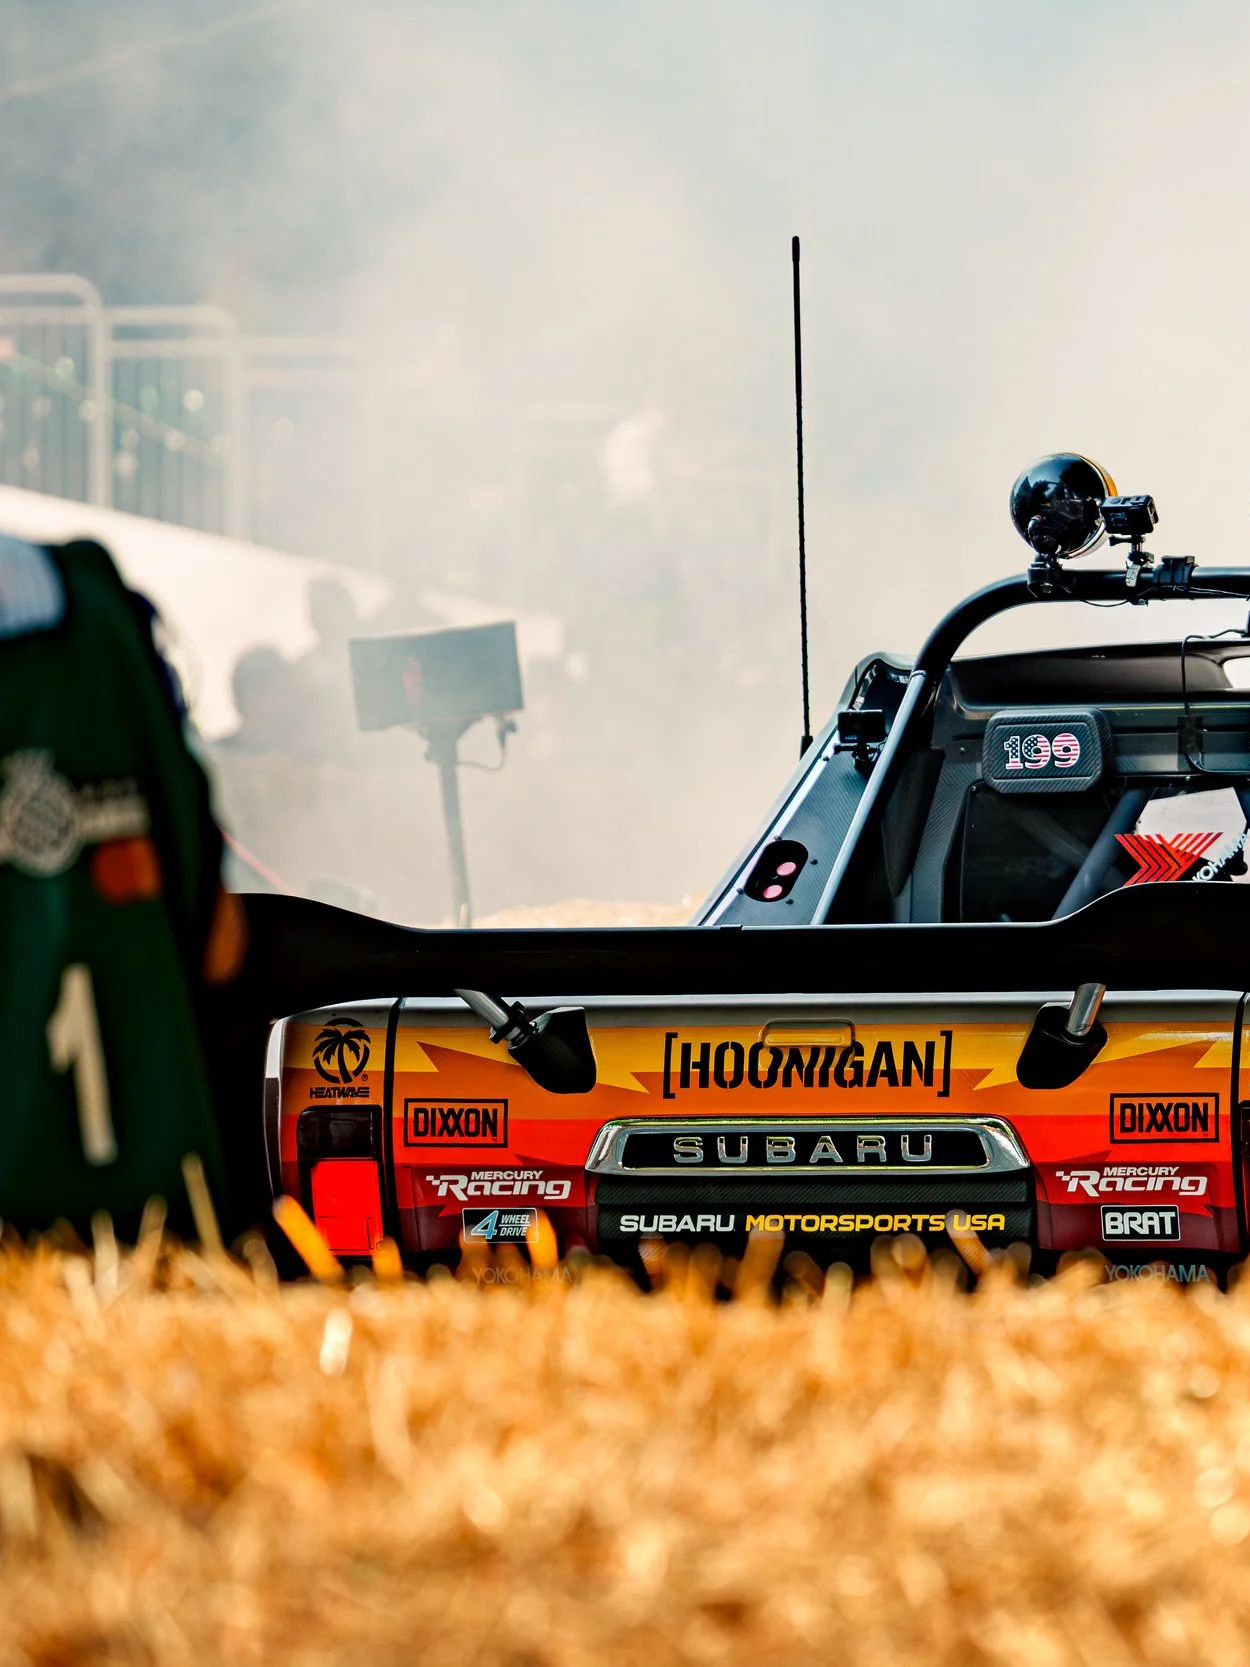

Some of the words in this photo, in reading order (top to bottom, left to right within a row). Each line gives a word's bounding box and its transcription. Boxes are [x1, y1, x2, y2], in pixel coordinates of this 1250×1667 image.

[1003, 732, 1081, 770] 199
[46, 962, 118, 1166] 1
[309, 1086, 370, 1099] HEATWAVE
[413, 1107, 498, 1138] DIXXON
[1119, 1102, 1209, 1133] DIXXON
[673, 1135, 932, 1164] SUBARU
[470, 1170, 543, 1180] MERCURY
[1064, 1170, 1208, 1197] Racing
[1103, 1166, 1180, 1176] MERCURY
[433, 1174, 572, 1201] Racing
[470, 1210, 499, 1240] 4
[501, 1214, 530, 1224] WHEEL
[620, 1214, 734, 1232] SUBARU
[745, 1214, 945, 1232] MOTORSPORTS
[952, 1213, 1005, 1231] USA
[1104, 1211, 1177, 1235] BRAT
[499, 1227, 527, 1237] DRIVE
[1104, 1264, 1210, 1283] YOKOHAMA
